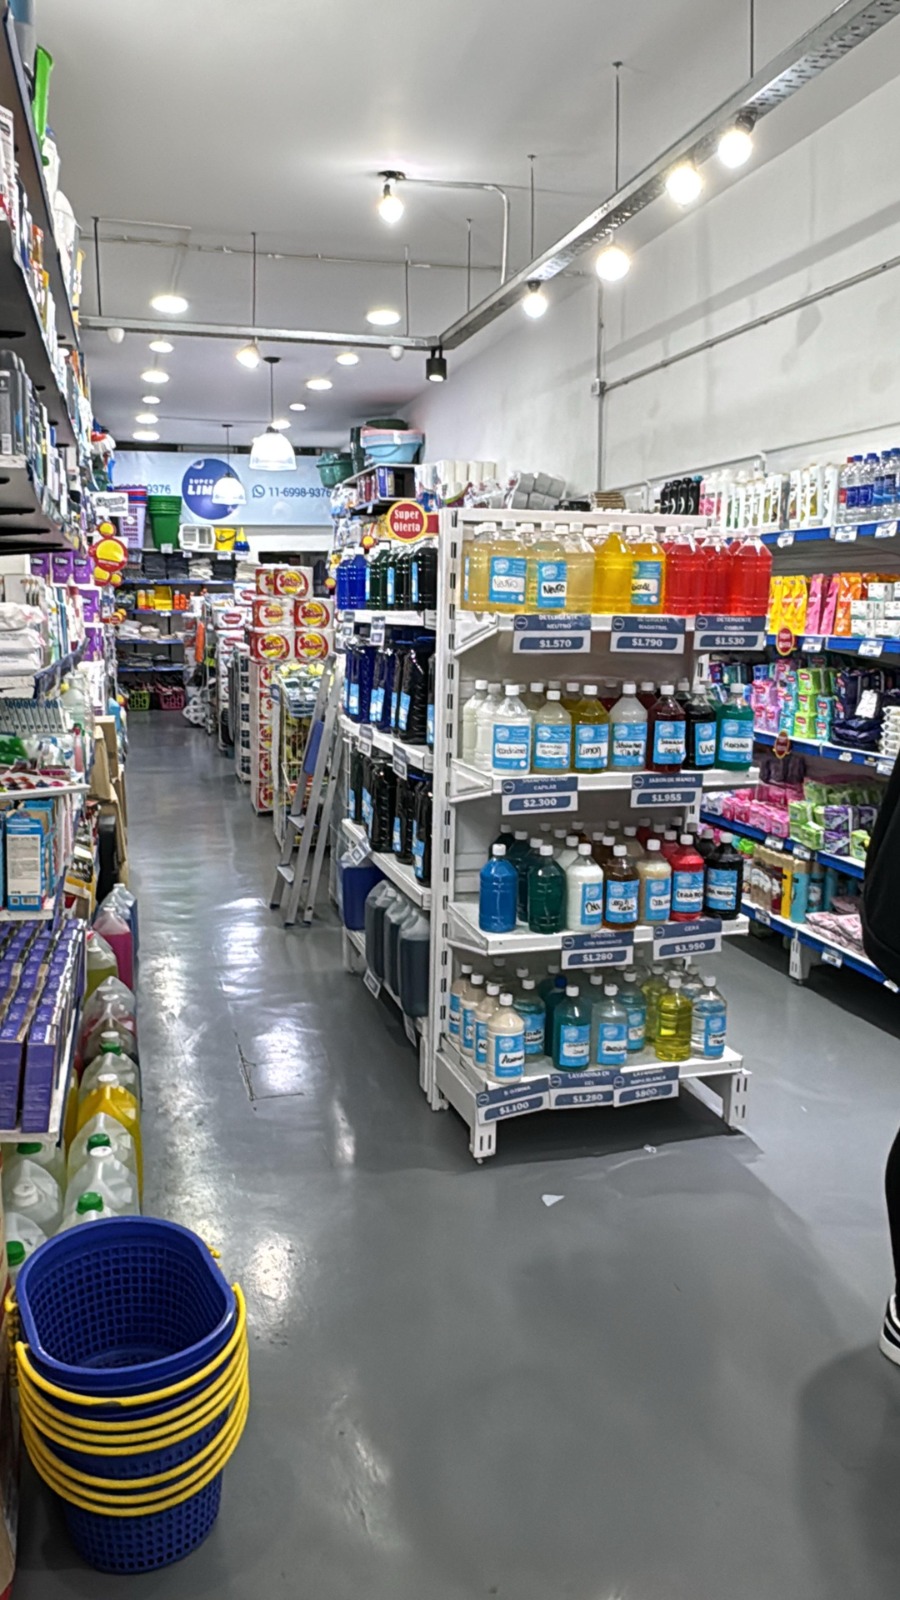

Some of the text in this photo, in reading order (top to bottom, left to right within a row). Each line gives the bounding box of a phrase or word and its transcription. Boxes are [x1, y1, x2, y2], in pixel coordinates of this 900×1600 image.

[394, 509, 420, 521] Super
[393, 521, 421, 532] Oferta
[539, 636, 572, 648] $1.570
[631, 638, 663, 648] $1.790
[715, 637, 745, 646] $1.530
[523, 797, 557, 808] $2.300
[651, 793, 682, 803] $1.955
